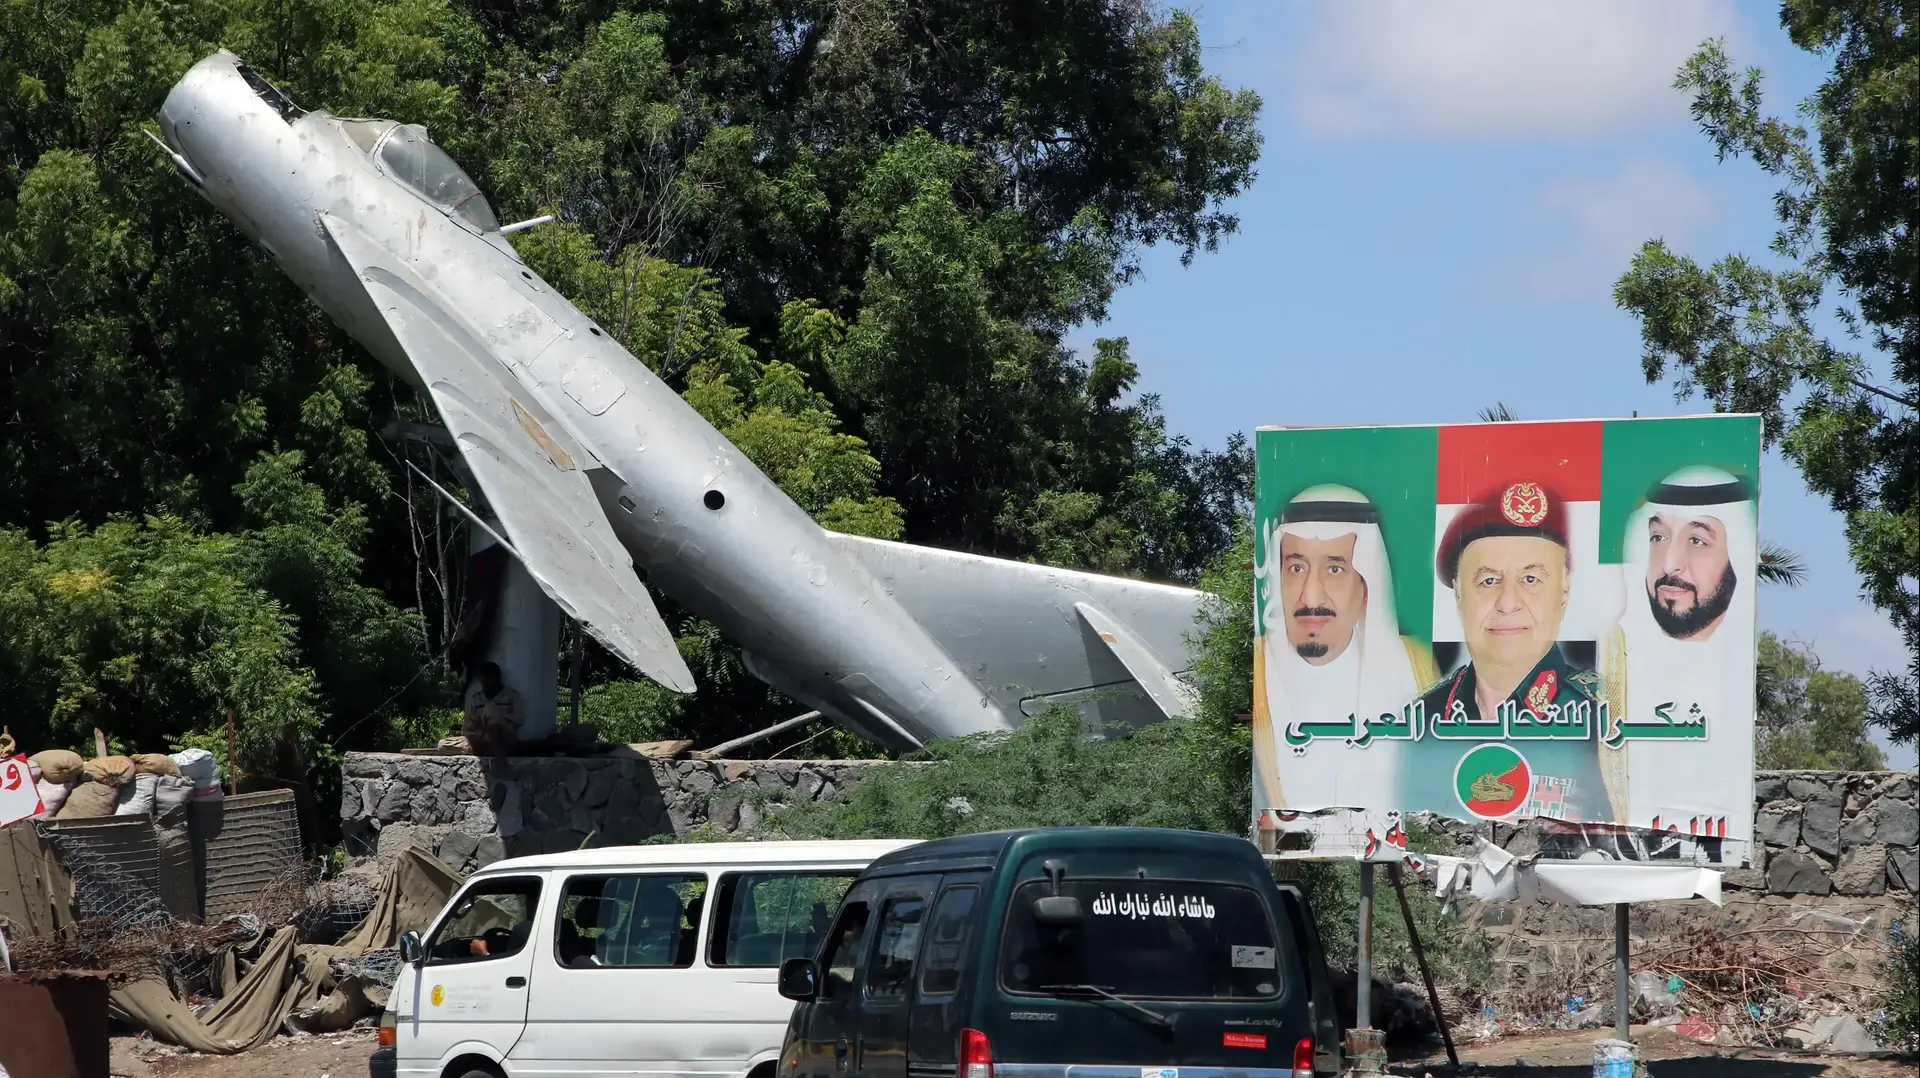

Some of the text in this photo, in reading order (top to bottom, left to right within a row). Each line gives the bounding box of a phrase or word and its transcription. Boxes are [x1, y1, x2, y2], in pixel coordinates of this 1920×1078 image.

[1285, 699, 1708, 757] شكرا للتحالف العربي
[1092, 891, 1117, 916] الله
[1119, 892, 1151, 921] تبارك
[1152, 892, 1177, 917] الله
